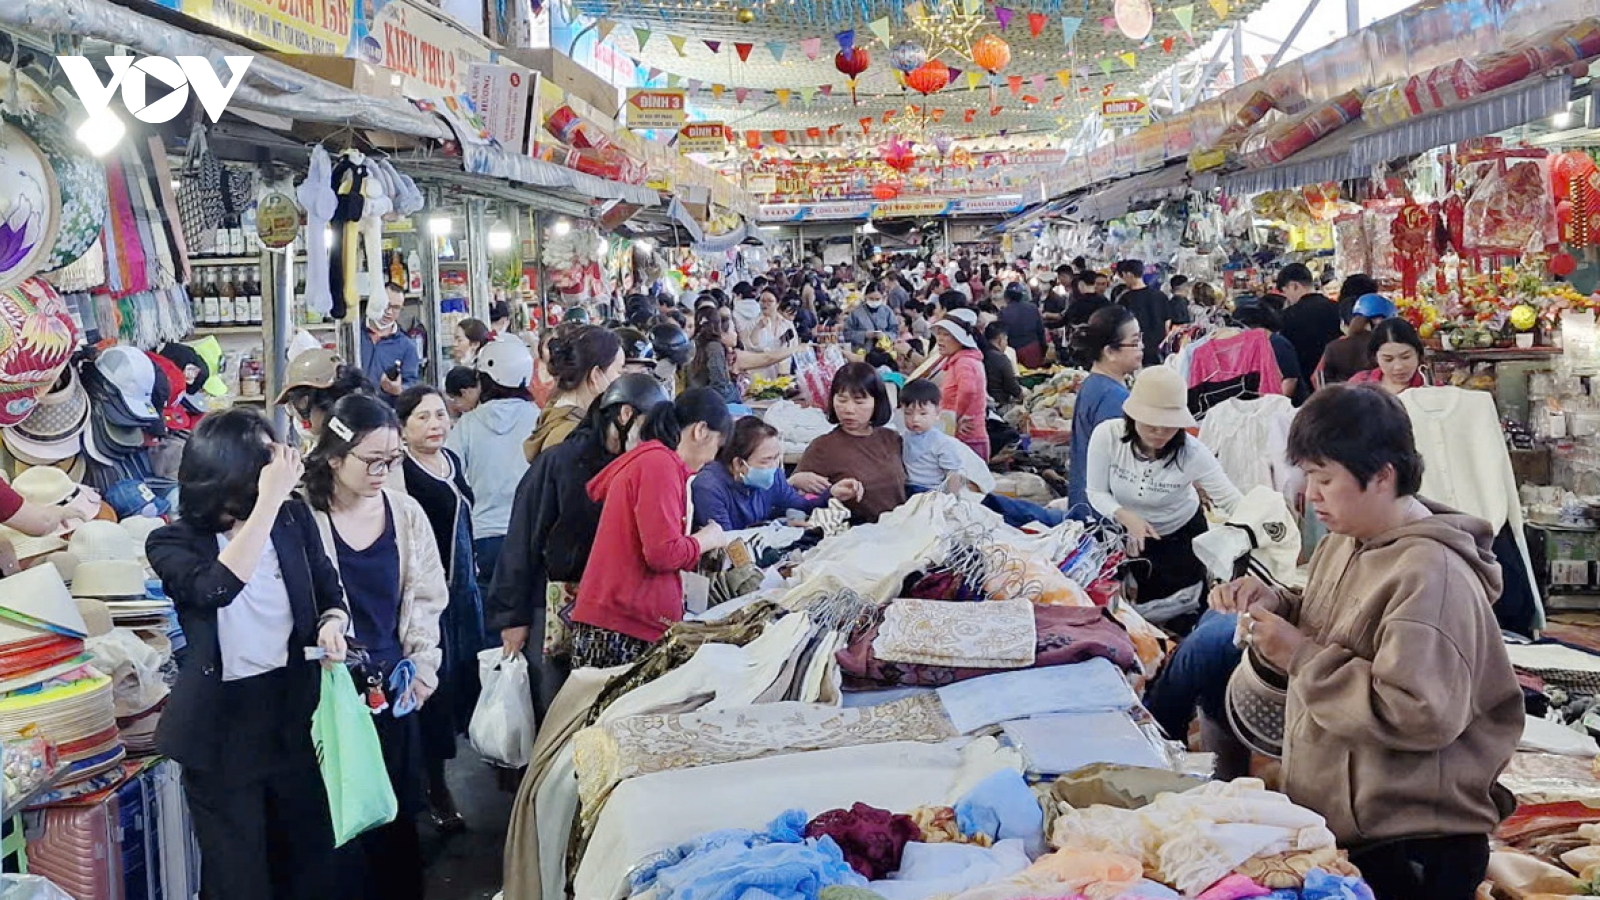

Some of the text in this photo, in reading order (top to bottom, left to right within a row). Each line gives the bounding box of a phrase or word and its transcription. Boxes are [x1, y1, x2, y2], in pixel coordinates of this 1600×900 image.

[640, 93, 680, 108] ĐÌNH 3
[1130, 102, 1138, 112] 7
[689, 125, 720, 137] ĐÌNH 3
